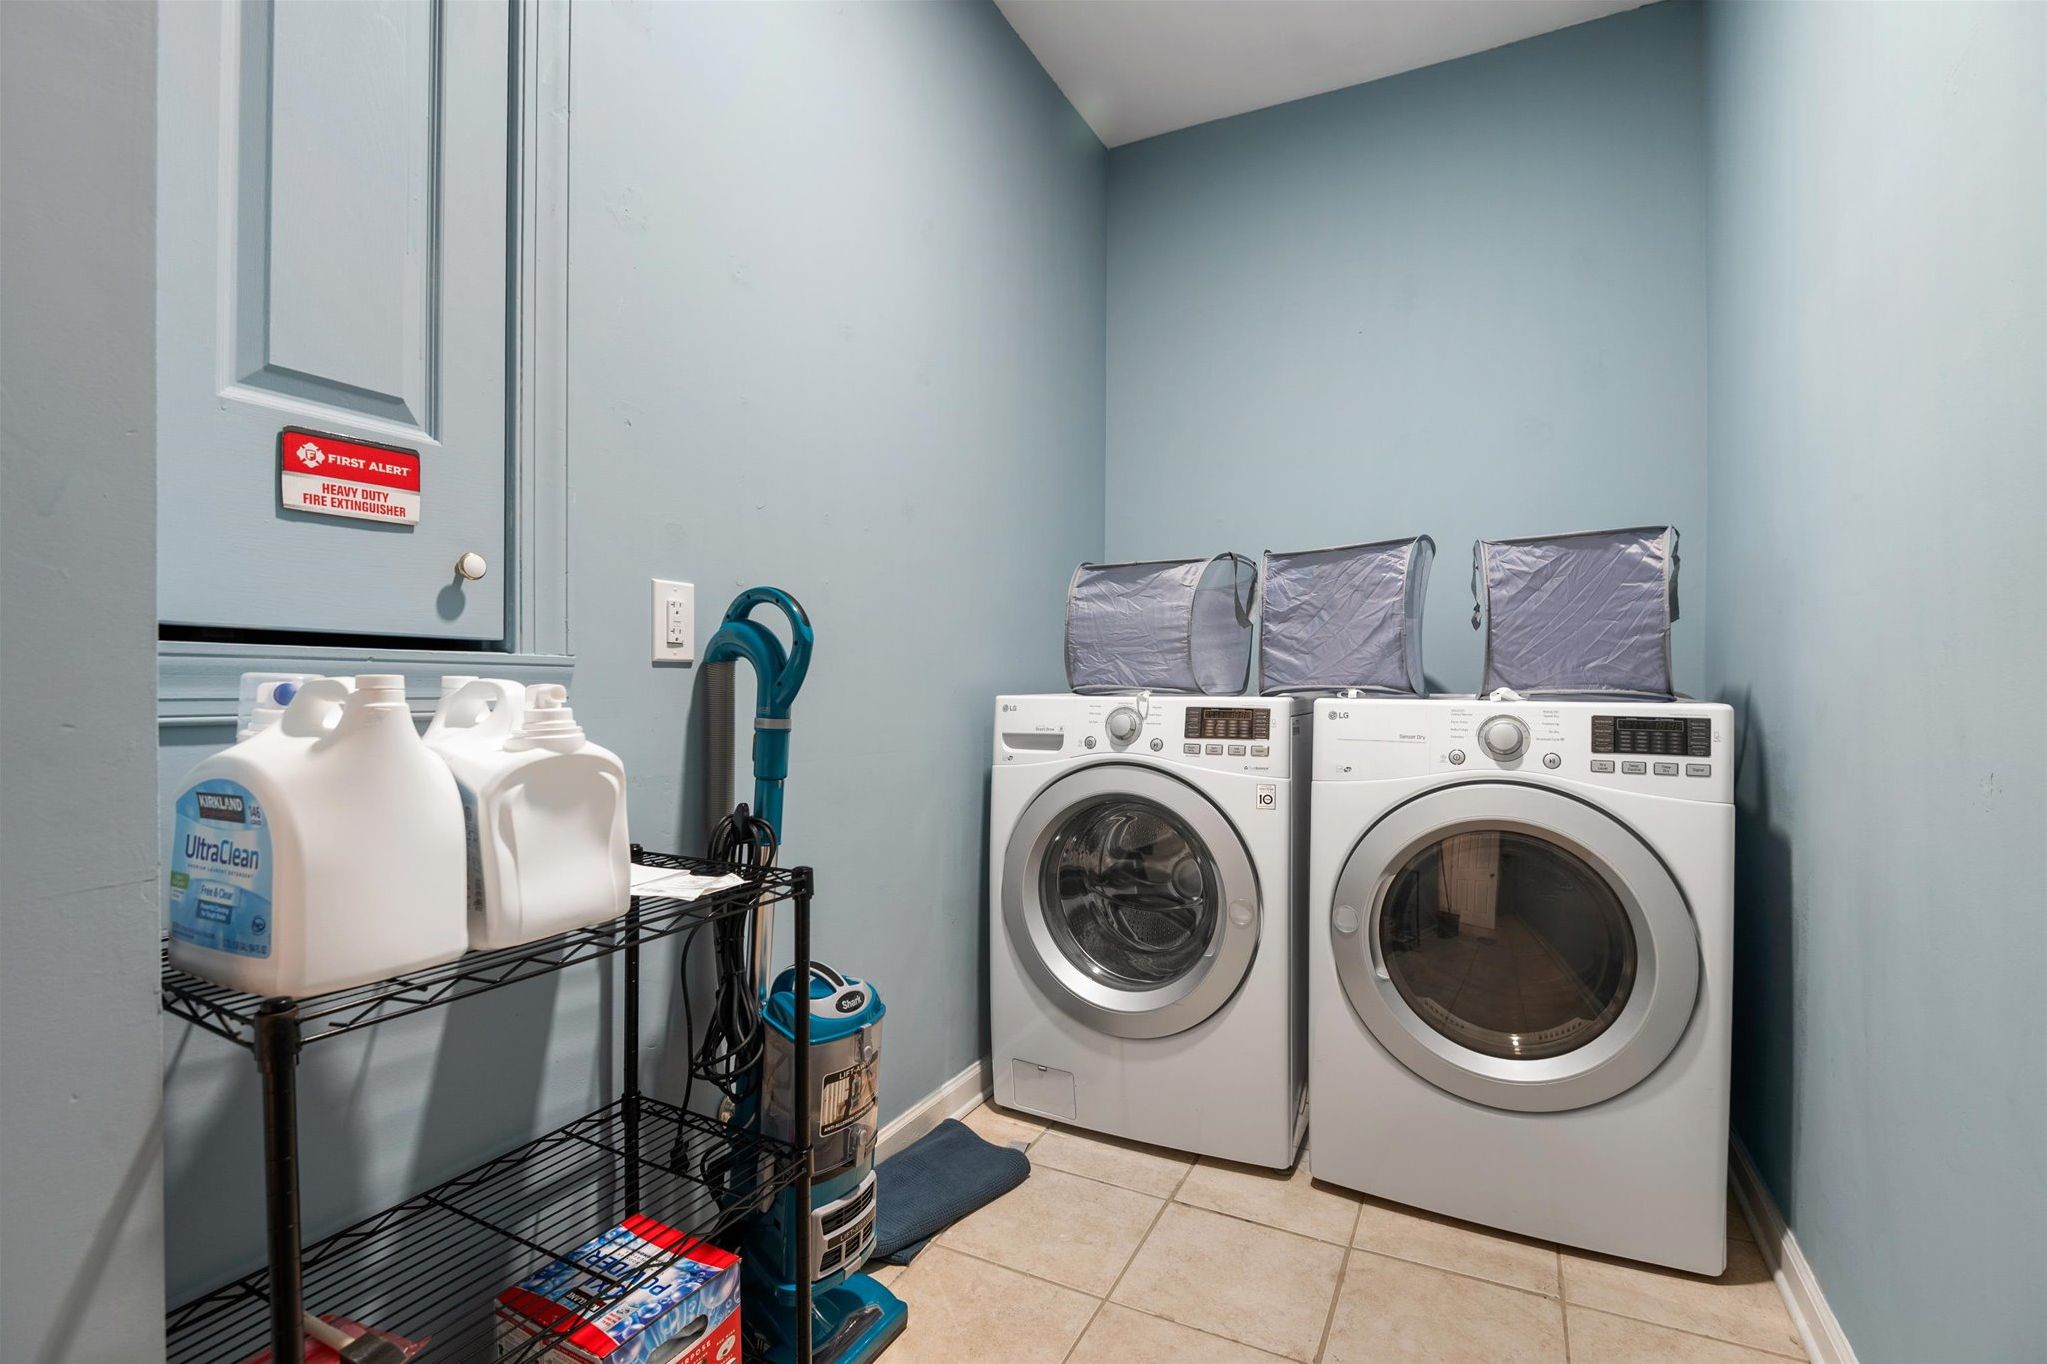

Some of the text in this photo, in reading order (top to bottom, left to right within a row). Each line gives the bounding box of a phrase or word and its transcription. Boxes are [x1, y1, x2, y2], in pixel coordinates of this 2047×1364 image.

[328, 454, 410, 477] FIRST ALERT
[322, 483, 389, 503] HEAVY DUTY
[303, 492, 406, 518] FIRE EXTINGUISHER
[198, 794, 243, 811] KIRKLAND
[185, 834, 260, 870] UltraClean
[841, 995, 862, 1010] Shark
